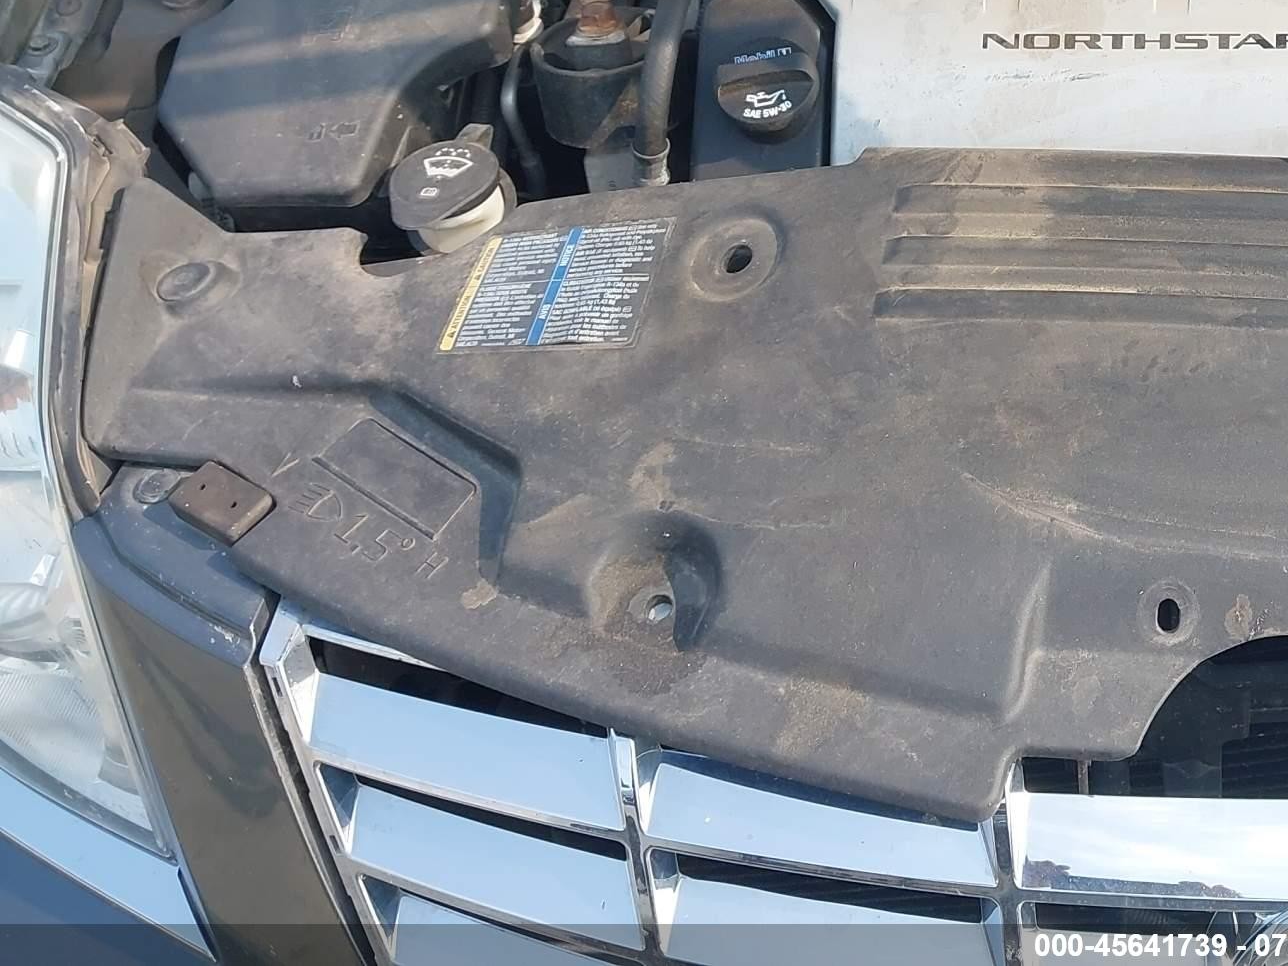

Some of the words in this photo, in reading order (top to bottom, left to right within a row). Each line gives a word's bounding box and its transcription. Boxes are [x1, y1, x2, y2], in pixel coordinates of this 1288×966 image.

[743, 108, 761, 119] SAE
[762, 100, 793, 118] 5W-30
[538, 303, 551, 320] AVIS
[415, 552, 449, 579] H
